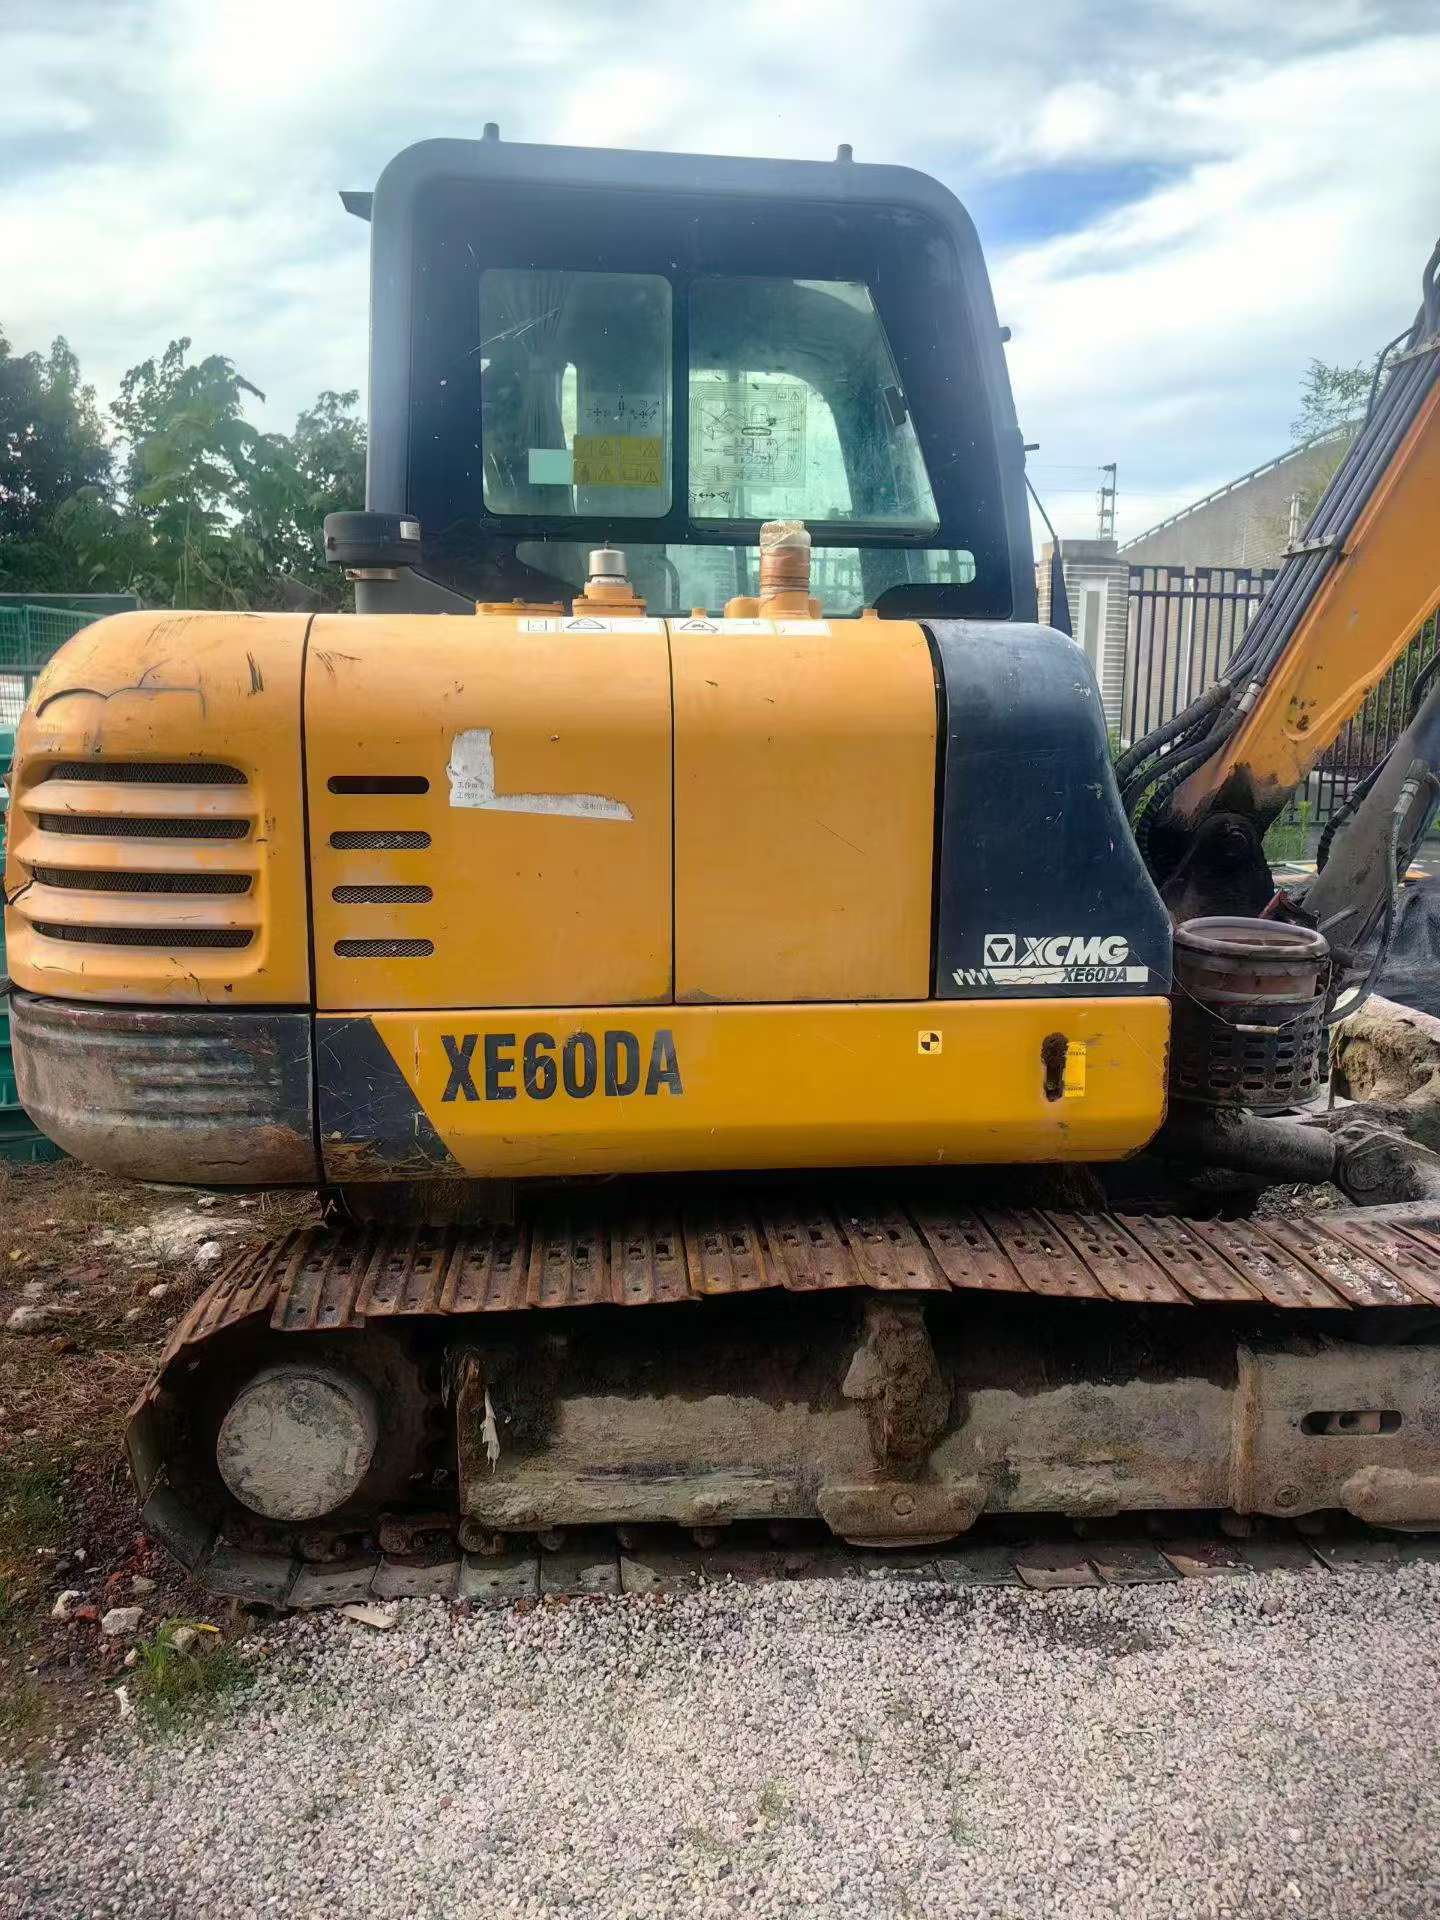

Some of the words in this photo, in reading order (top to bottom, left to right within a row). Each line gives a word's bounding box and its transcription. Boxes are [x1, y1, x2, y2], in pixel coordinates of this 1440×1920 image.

[1016, 936, 1129, 966] XCMG
[1061, 967, 1127, 983] XE60DA
[440, 1029, 683, 1103] XE60DA
